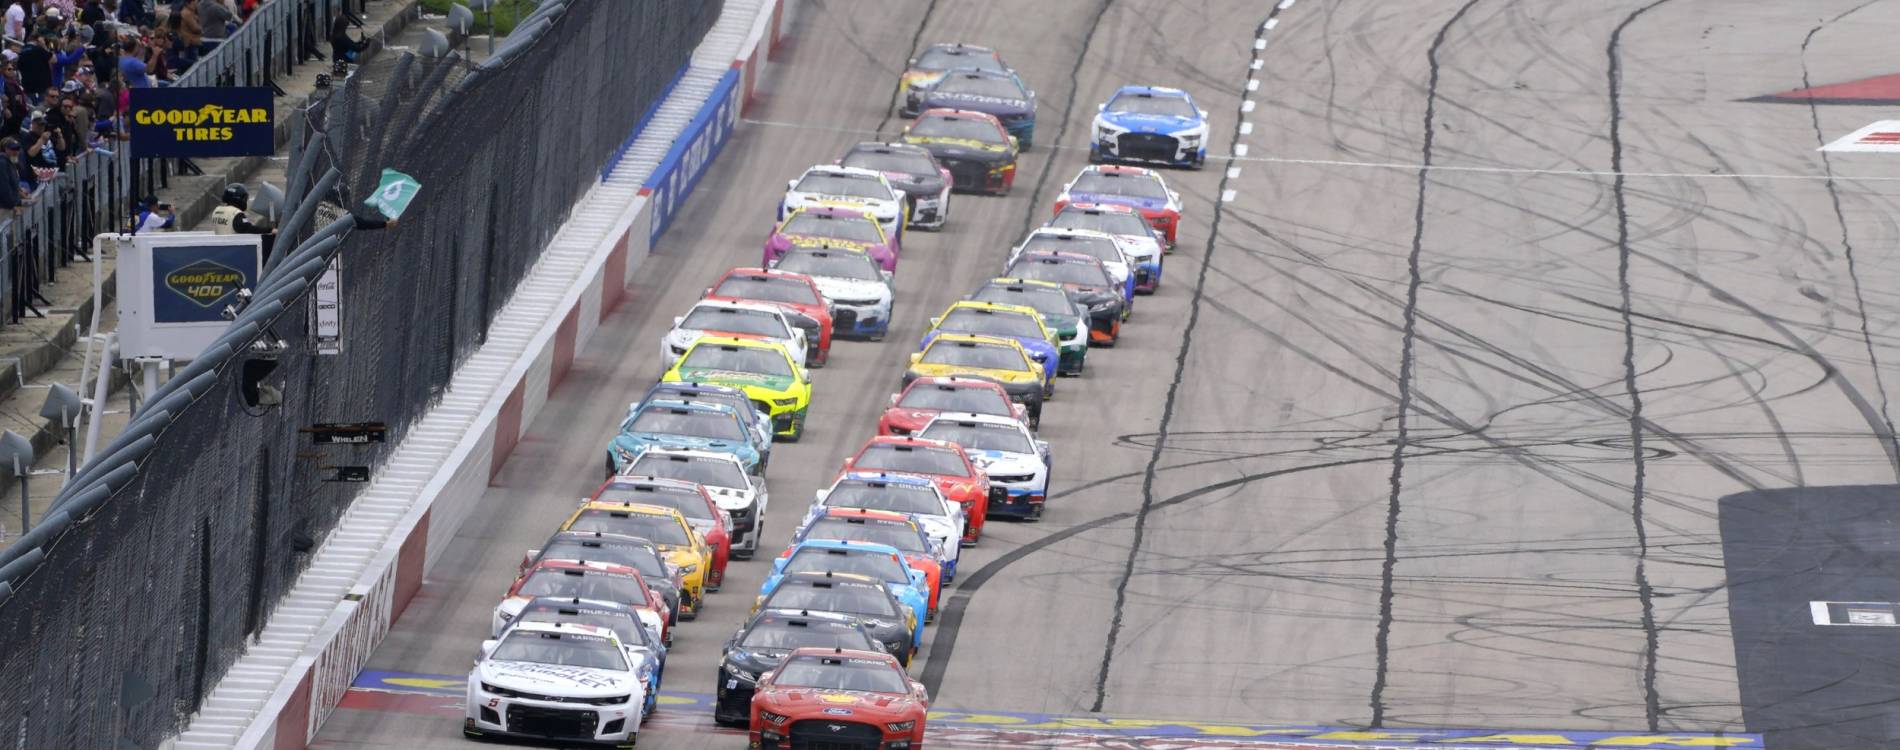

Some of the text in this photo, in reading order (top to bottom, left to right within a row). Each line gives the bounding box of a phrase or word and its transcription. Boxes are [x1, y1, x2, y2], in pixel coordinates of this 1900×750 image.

[135, 104, 267, 126] GOODYEAR
[173, 127, 233, 141] TIRES
[187, 285, 223, 297] 400
[898, 483, 932, 492] DILLON
[577, 608, 610, 616] TRUEX
[571, 634, 607, 643] LARSON
[848, 658, 886, 666] LOGANO
[488, 698, 500, 708] 5
